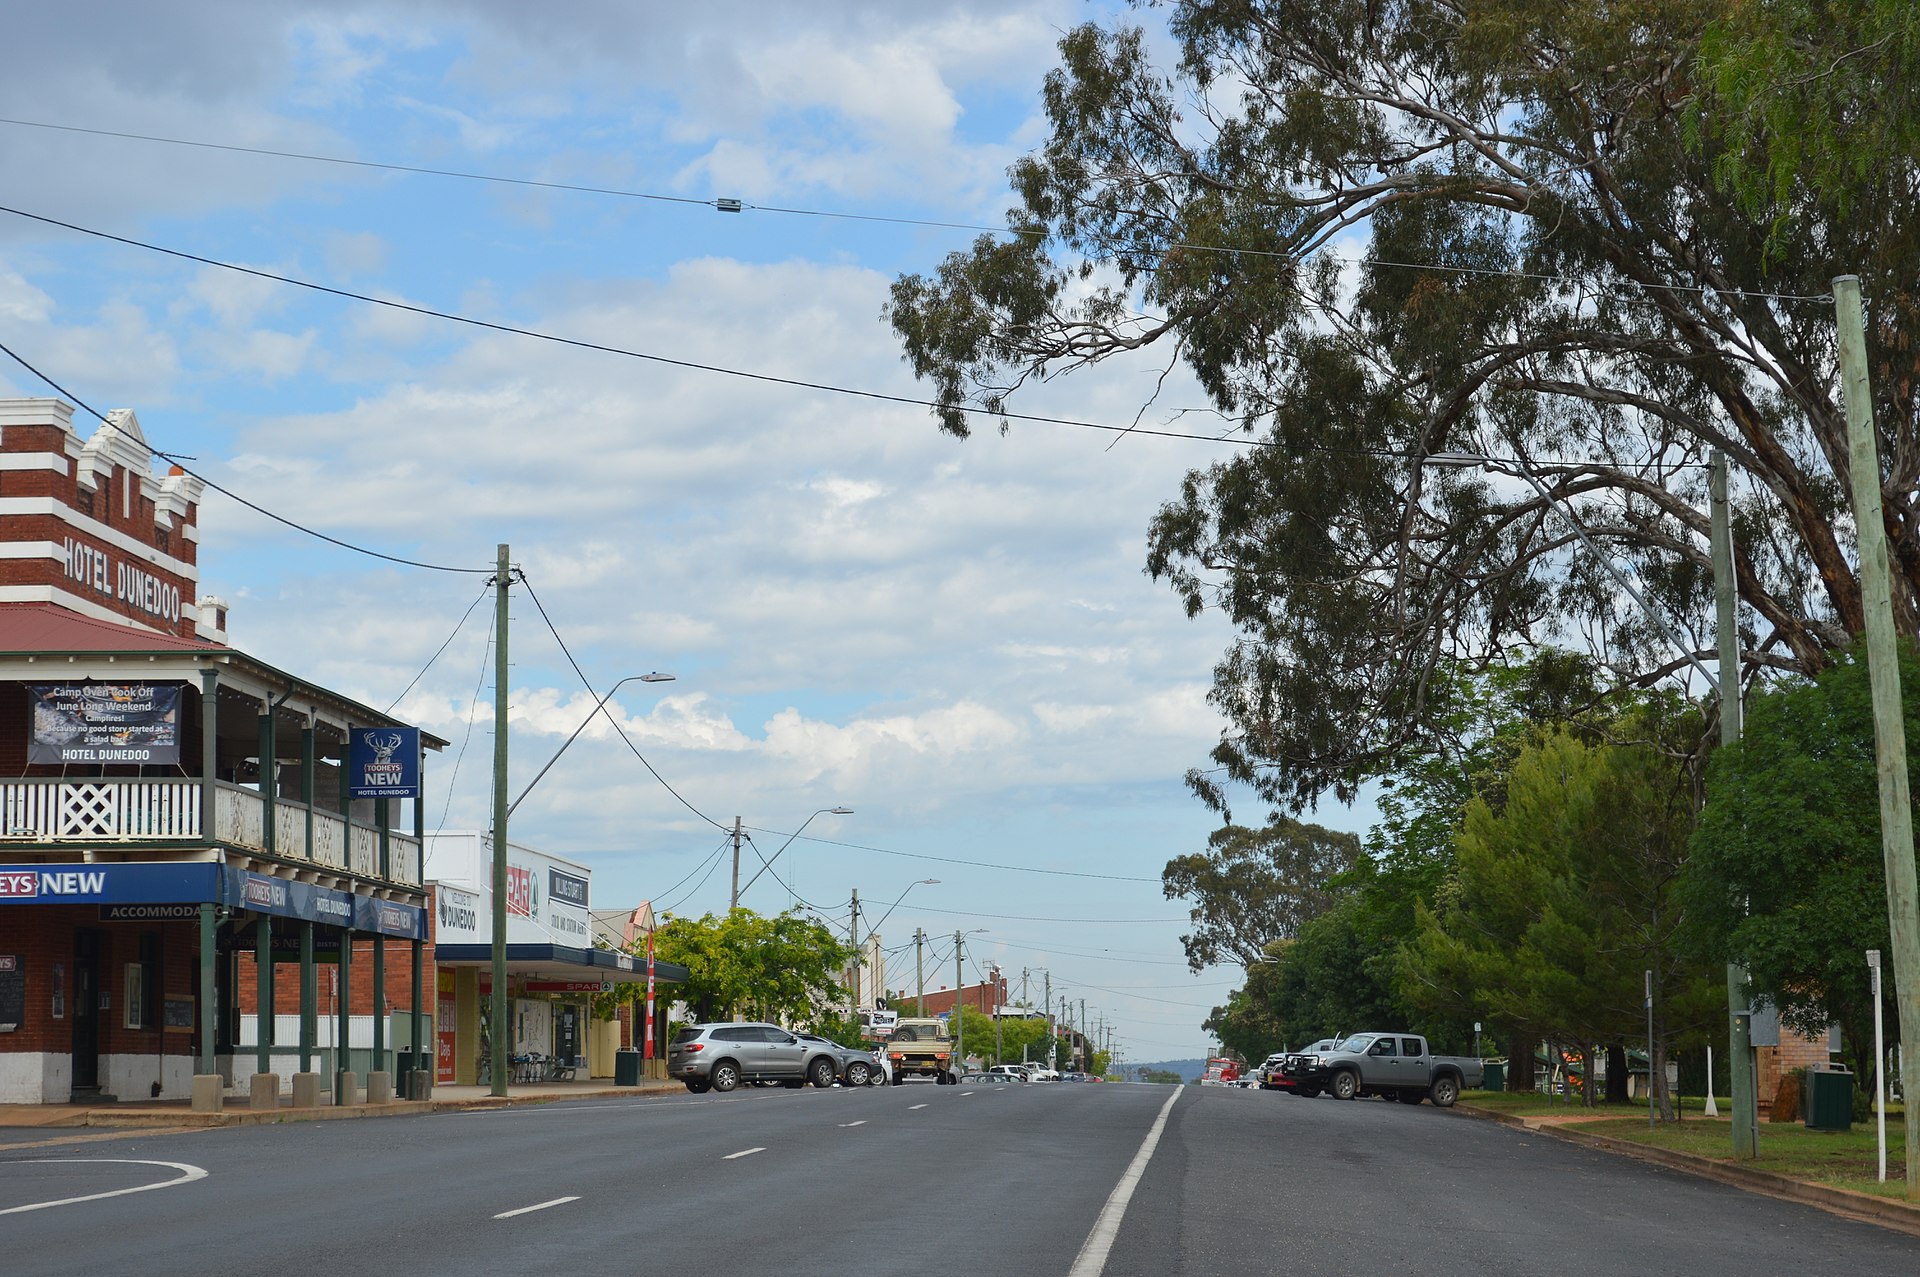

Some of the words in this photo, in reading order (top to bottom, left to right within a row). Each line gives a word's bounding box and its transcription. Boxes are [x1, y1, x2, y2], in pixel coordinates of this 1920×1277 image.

[64, 536, 112, 595] HOTEL
[117, 561, 180, 623] DUNEDOO
[53, 688, 82, 699] Camp
[83, 688, 109, 697] Oven
[138, 687, 154, 697] Off
[55, 702, 79, 711] June
[80, 702, 104, 713] Long
[105, 702, 151, 711] Weekend
[85, 714, 125, 723] Campfires!
[88, 725, 107, 734] good
[108, 726, 127, 734] story
[62, 750, 96, 760] HOTEL
[98, 750, 150, 760] DUNEDOO
[367, 764, 400, 772] TOOHEYS
[364, 773, 402, 786] NEW
[0, 876, 33, 893] EYS
[41, 872, 106, 895] NEW
[248, 882, 270, 902] TOOHEYS
[271, 885, 286, 907] NEW
[110, 906, 234, 918] ACCOMMODAON
[316, 897, 330, 913] HOTEL
[330, 900, 351, 917] DUNEDOO
[383, 910, 400, 926] TOOHEYS
[400, 911, 411, 929] NEW
[448, 905, 476, 932] DUNEDOO
